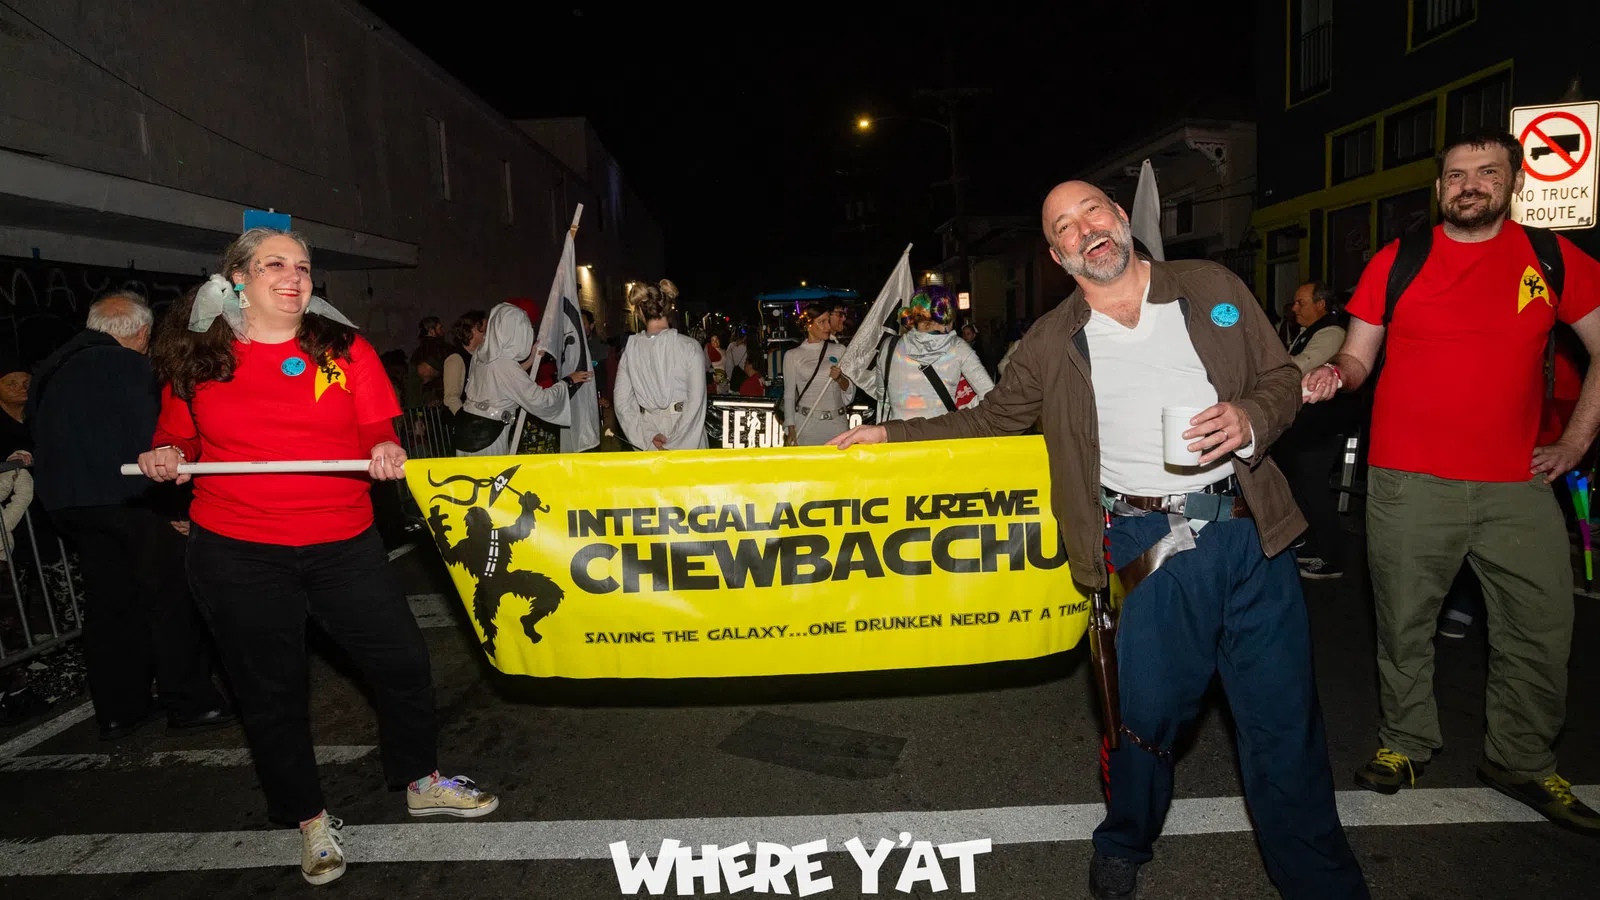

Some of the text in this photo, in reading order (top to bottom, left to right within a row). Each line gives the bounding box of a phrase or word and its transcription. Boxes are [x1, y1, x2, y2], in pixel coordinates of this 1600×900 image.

[1515, 186, 1589, 203] NO TRUCK
[1526, 205, 1577, 222] ROUTE
[493, 475, 509, 492] 42
[567, 489, 1040, 538] INTERGALACTIC KREWE
[584, 631, 656, 644] SAVING
[662, 630, 698, 642] THE
[855, 614, 943, 632] DRUNKEN
[950, 611, 1000, 626] NERD
[1008, 609, 1032, 623] AT
[1040, 607, 1051, 620] A
[1058, 600, 1089, 617] TIME
